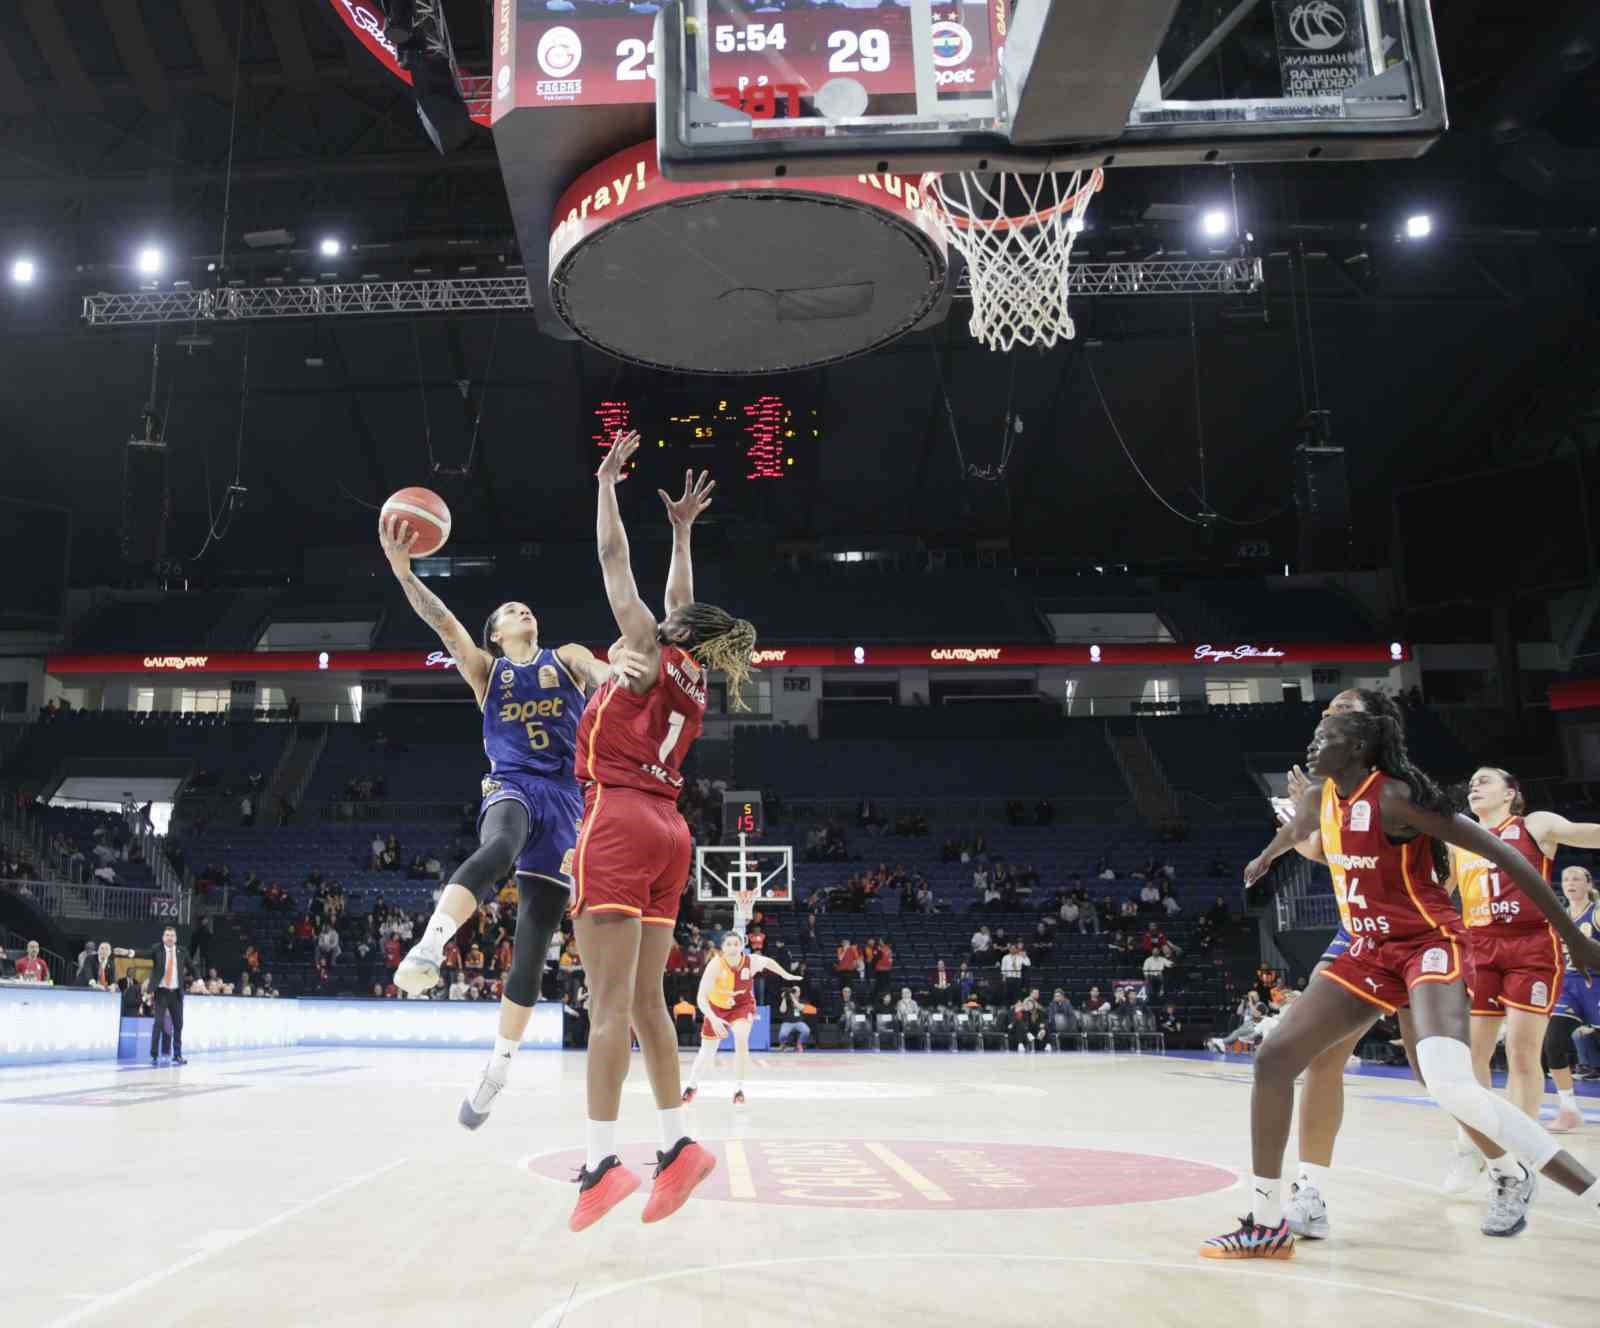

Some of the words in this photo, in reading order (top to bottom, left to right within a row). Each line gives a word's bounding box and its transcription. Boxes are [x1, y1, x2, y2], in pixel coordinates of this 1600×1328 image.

[715, 23, 787, 52] 5:54
[827, 29, 891, 73] 29
[666, 661, 706, 704] WILLIAMS
[499, 697, 563, 722] opet
[526, 721, 550, 751] 5
[152, 901, 179, 917] 126
